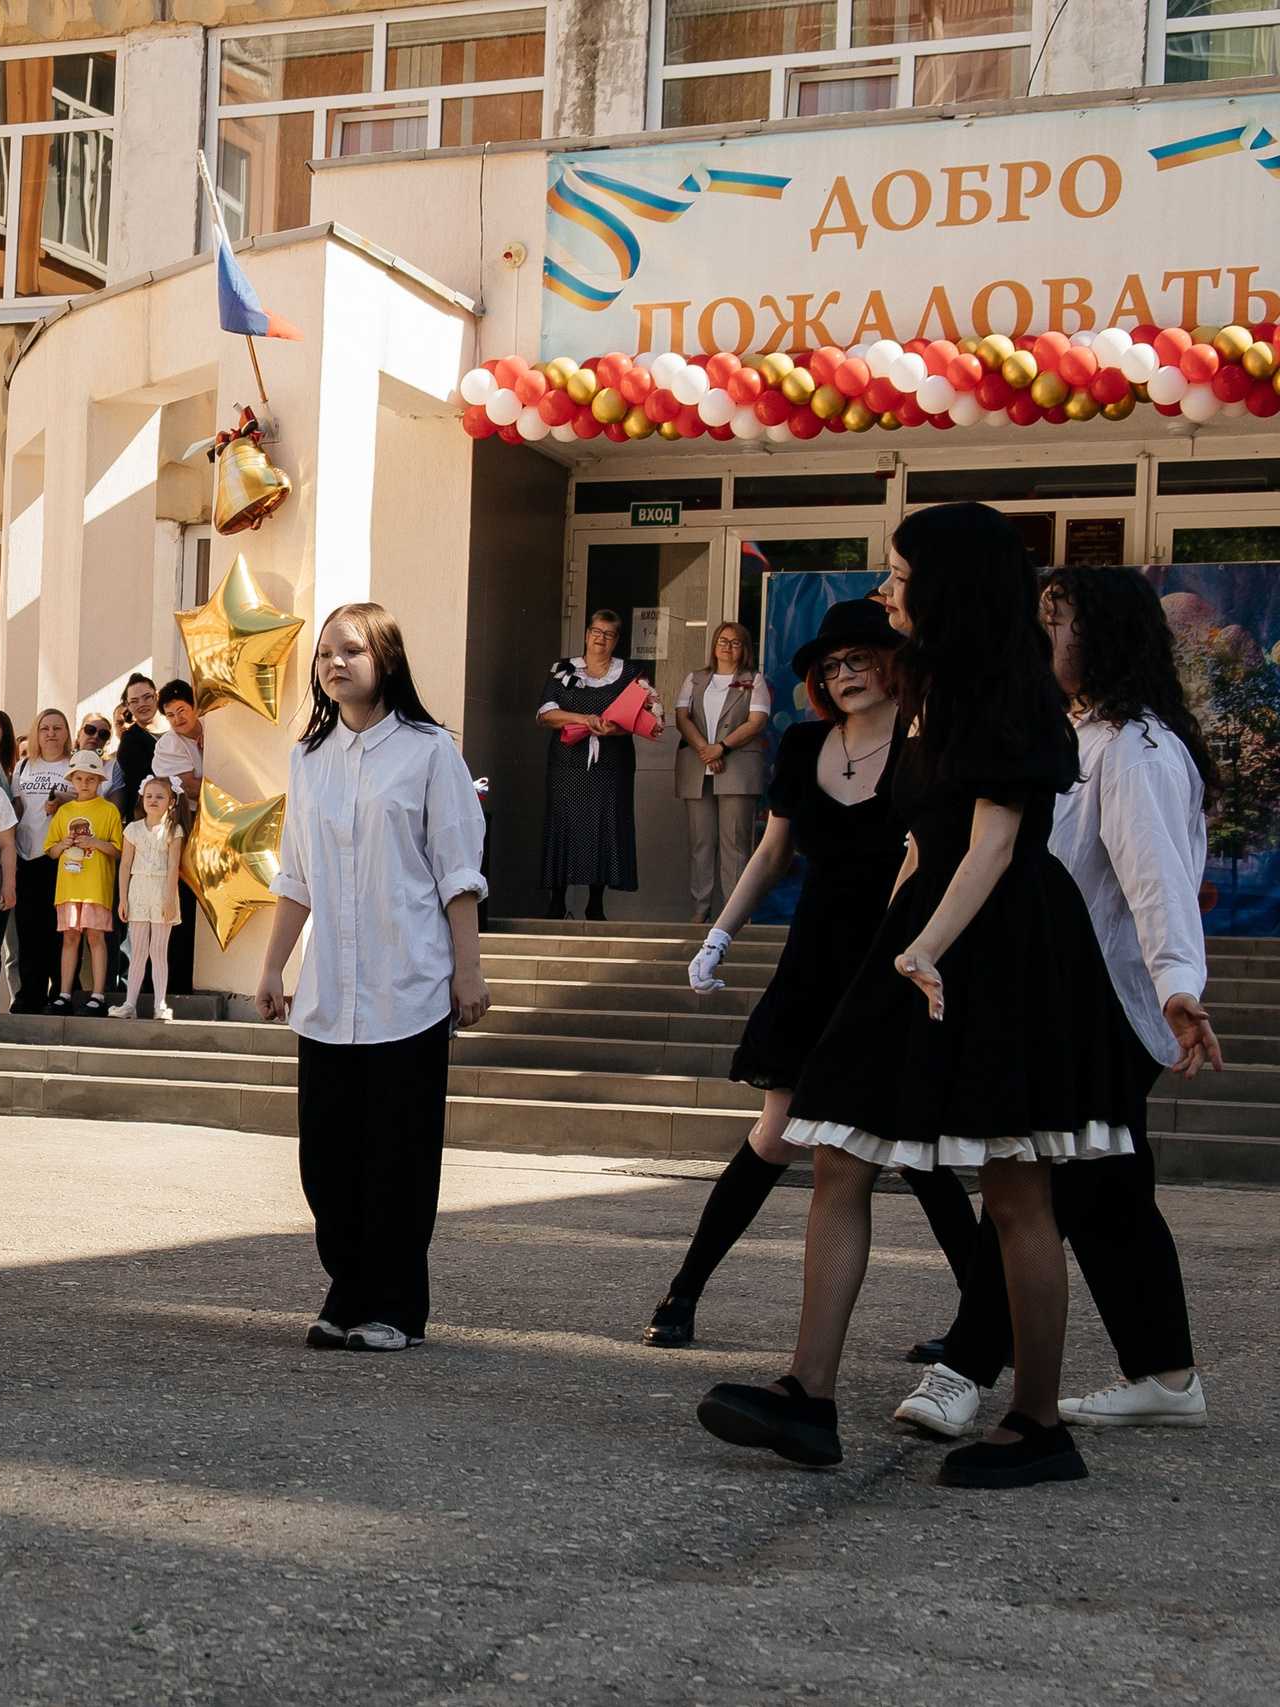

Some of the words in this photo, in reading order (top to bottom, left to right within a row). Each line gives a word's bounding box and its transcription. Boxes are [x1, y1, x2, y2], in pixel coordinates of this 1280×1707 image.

[810, 154, 1123, 253] ДОБРО
[631, 266, 1280, 357] ПОЖАЛОВАТЬ
[638, 507, 673, 523] ВХОД
[640, 611, 659, 621] ВХОД
[20, 782, 68, 792] ROOKLYN
